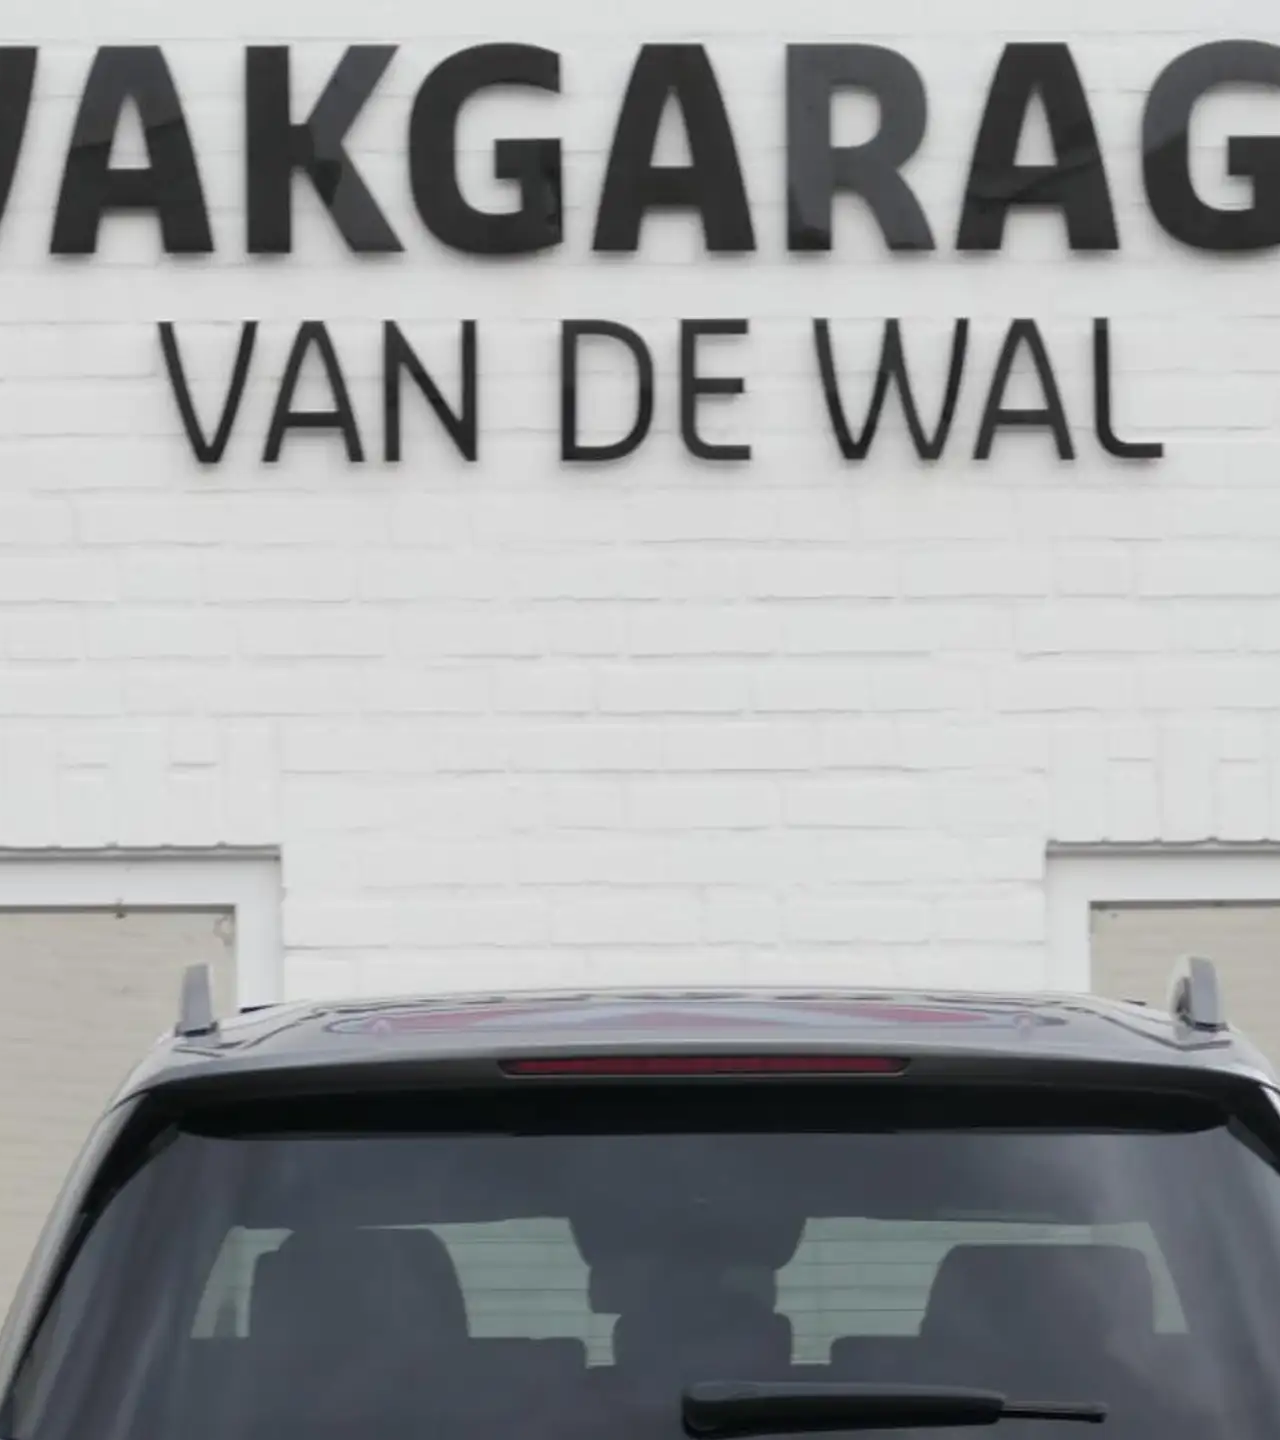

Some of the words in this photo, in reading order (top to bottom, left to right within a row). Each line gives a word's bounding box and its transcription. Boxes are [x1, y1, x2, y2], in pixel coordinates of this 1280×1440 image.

[157, 319, 478, 465] VAN
[559, 318, 752, 463] DE
[813, 317, 1165, 462] WAL
